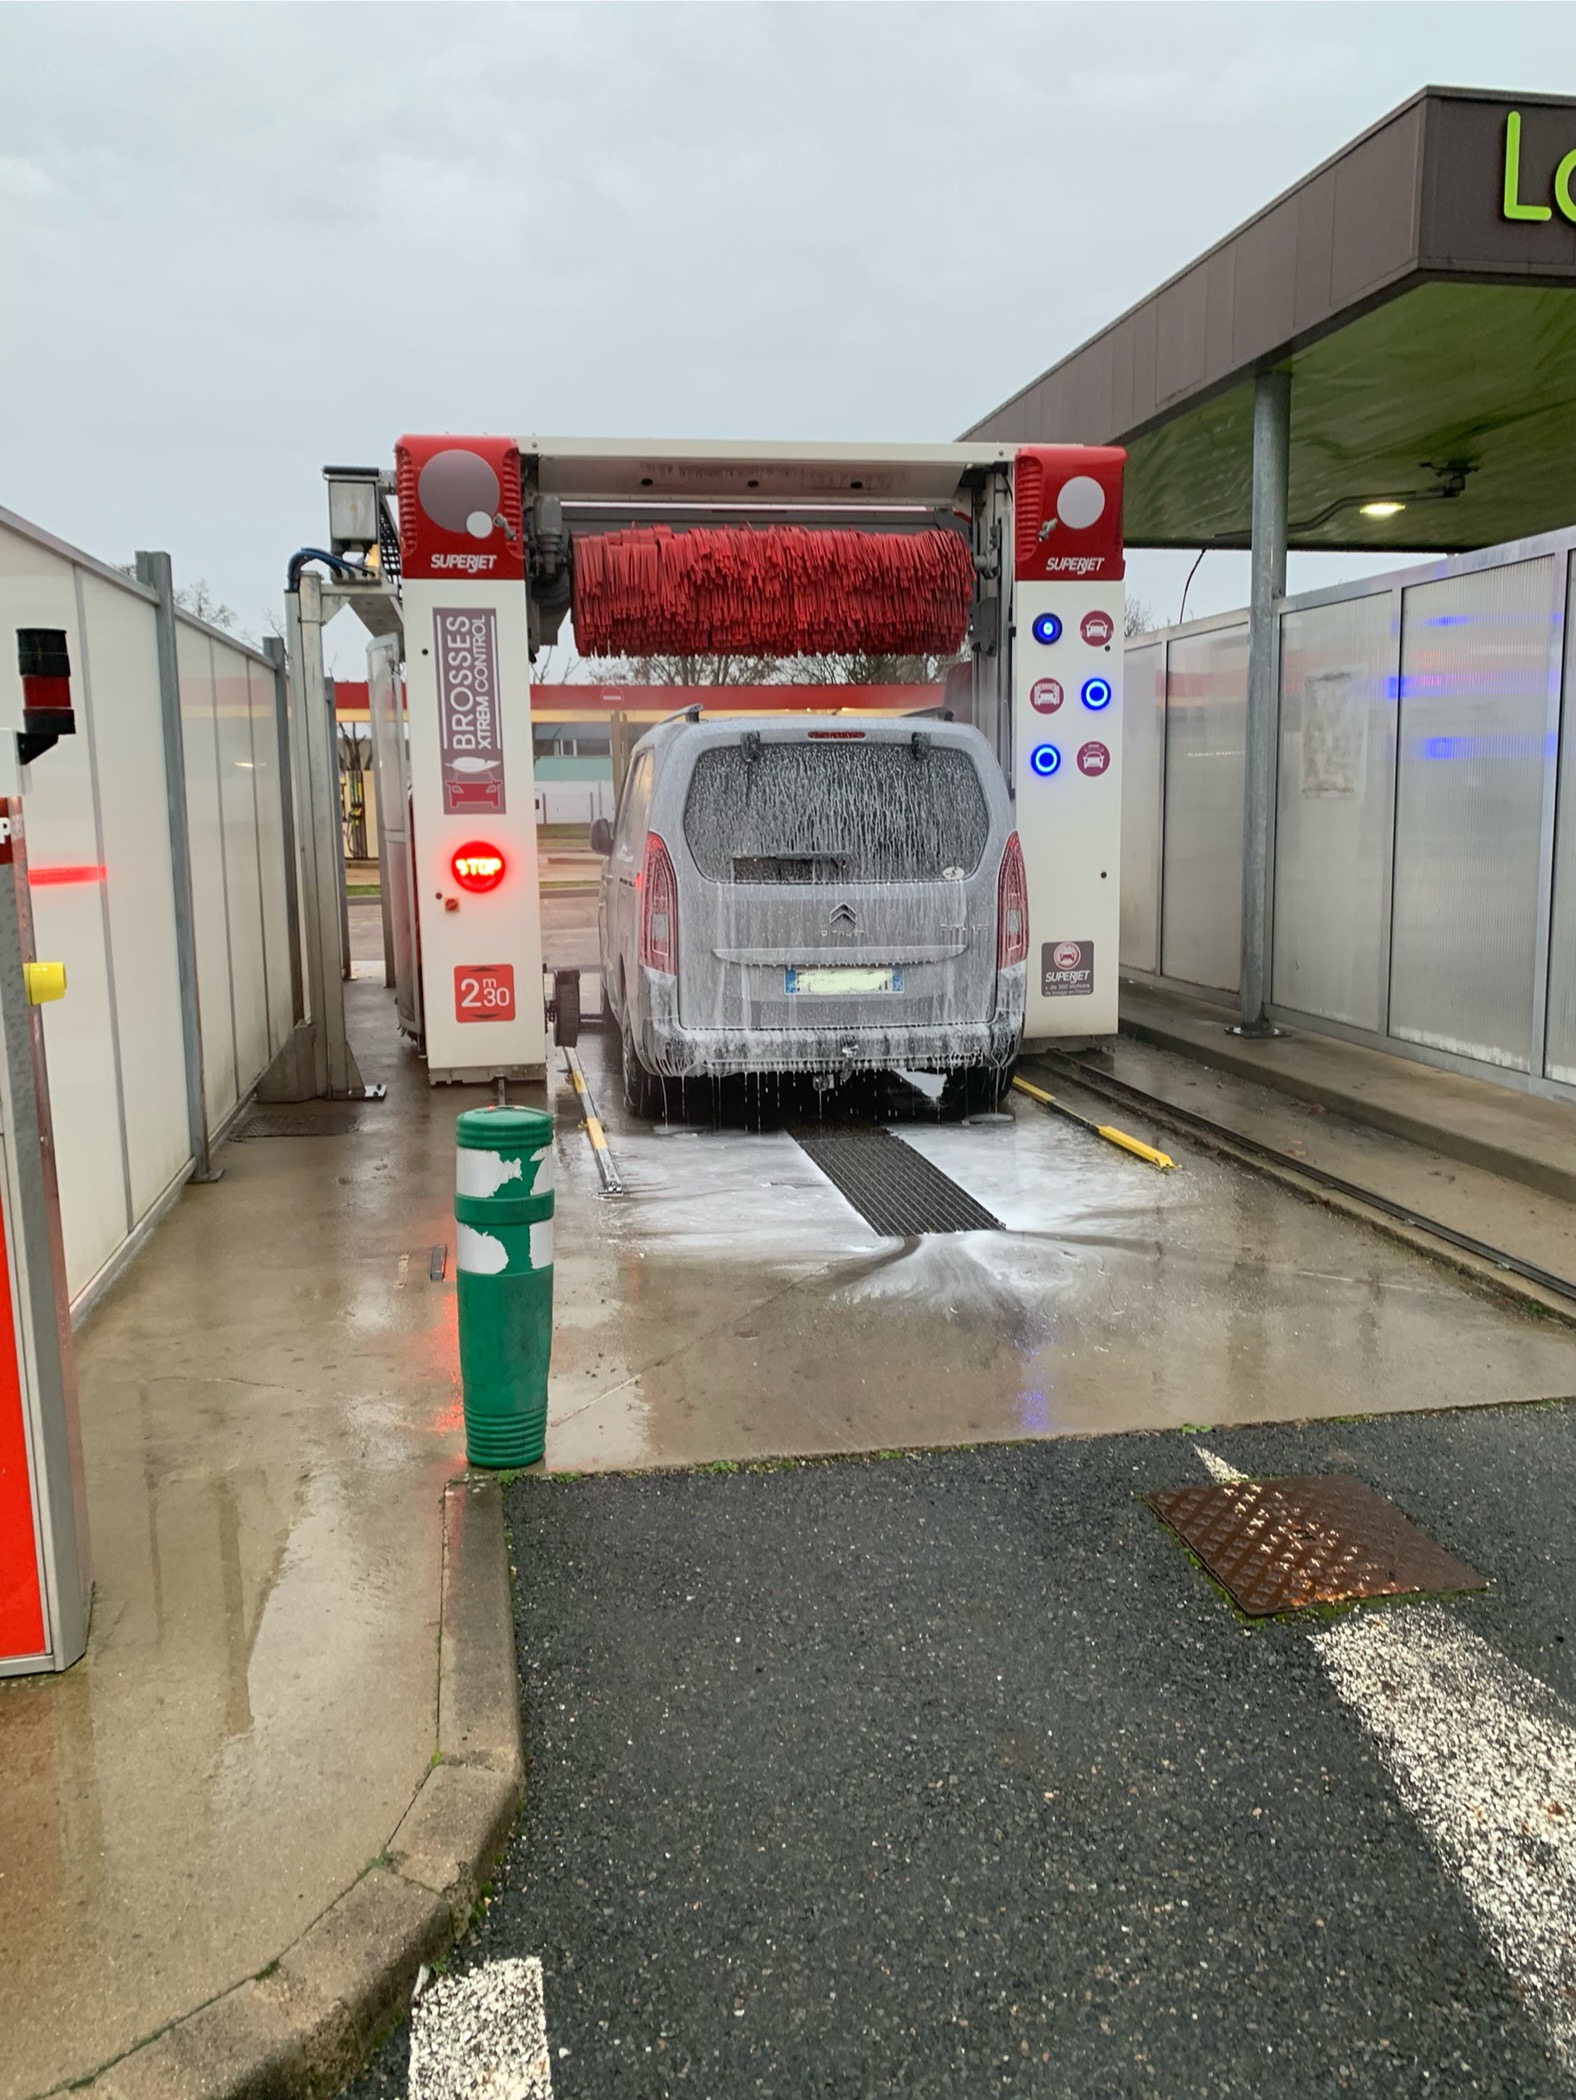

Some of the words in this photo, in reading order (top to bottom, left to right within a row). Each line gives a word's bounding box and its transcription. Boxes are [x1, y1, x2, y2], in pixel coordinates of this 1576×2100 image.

[430, 553, 497, 573] SUPERJET
[1045, 557, 1105, 575] SUPERJET
[471, 615, 488, 692] CONTROL
[446, 615, 476, 749] BROSSES
[475, 696, 491, 749] XTREM
[455, 857, 502, 876] STOP
[1045, 970, 1091, 984] SUPERJET
